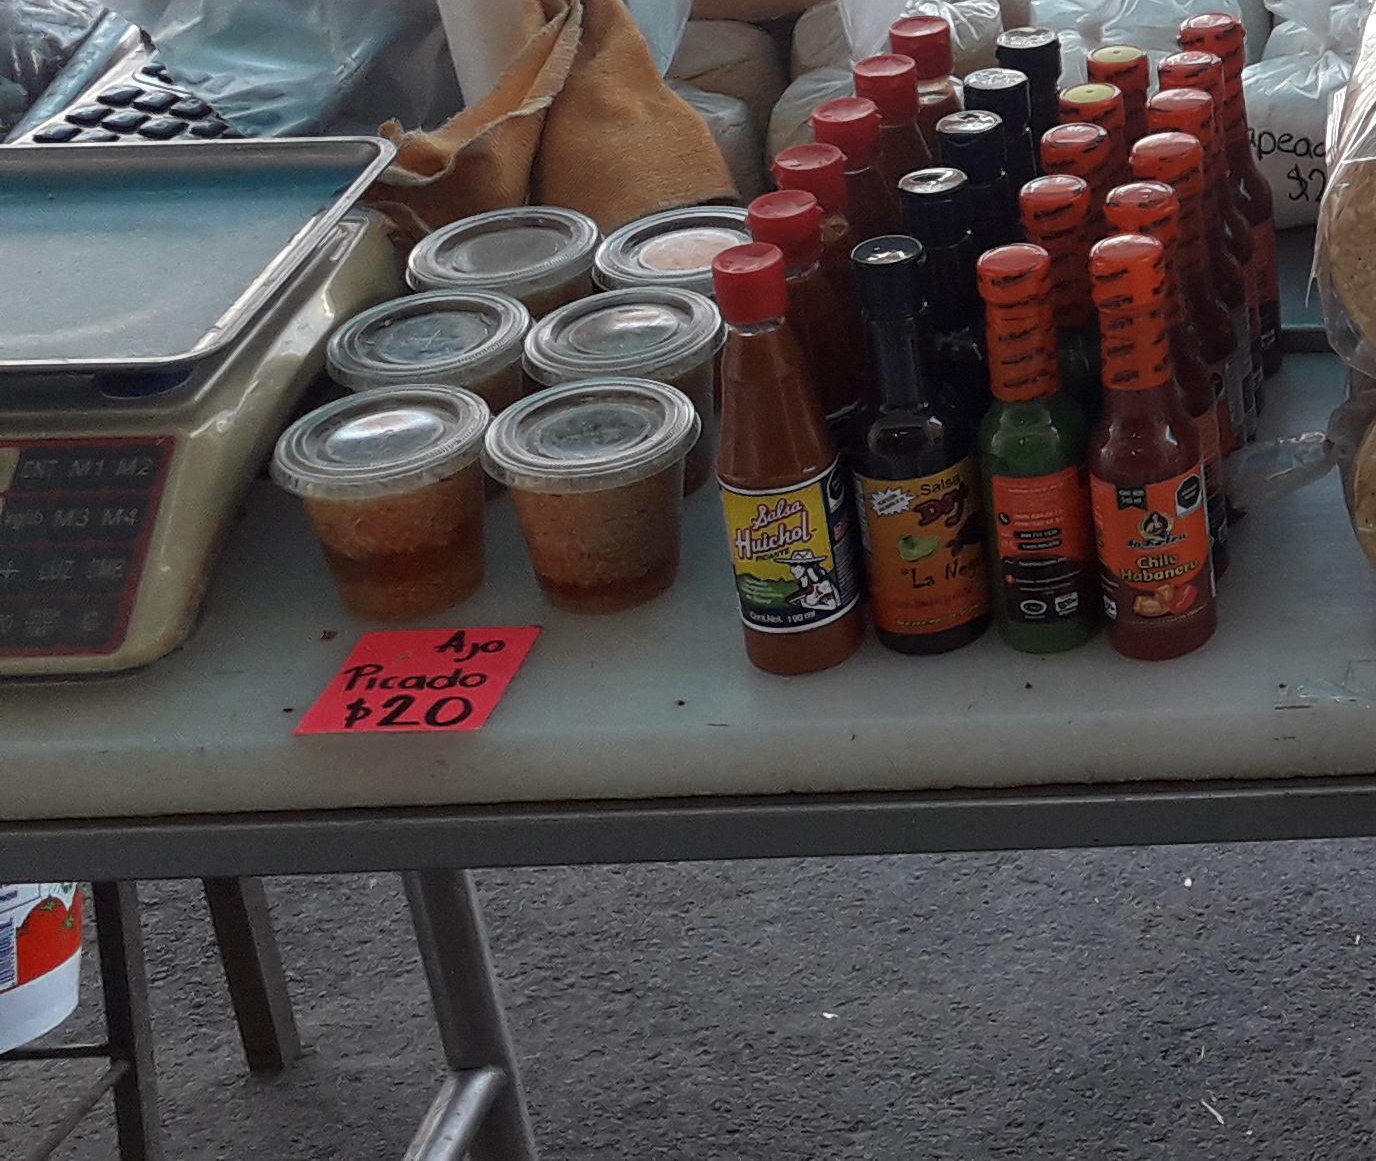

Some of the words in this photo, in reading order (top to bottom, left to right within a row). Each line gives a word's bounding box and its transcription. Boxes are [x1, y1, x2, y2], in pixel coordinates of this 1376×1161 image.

[920, 474, 963, 497] Salsa
[752, 498, 805, 532] Salsa
[735, 510, 813, 560] Huichol
[1120, 558, 1199, 584] Habanero
[1136, 553, 1180, 570] Chile
[345, 663, 488, 695] Picado
[344, 695, 474, 729] $20
